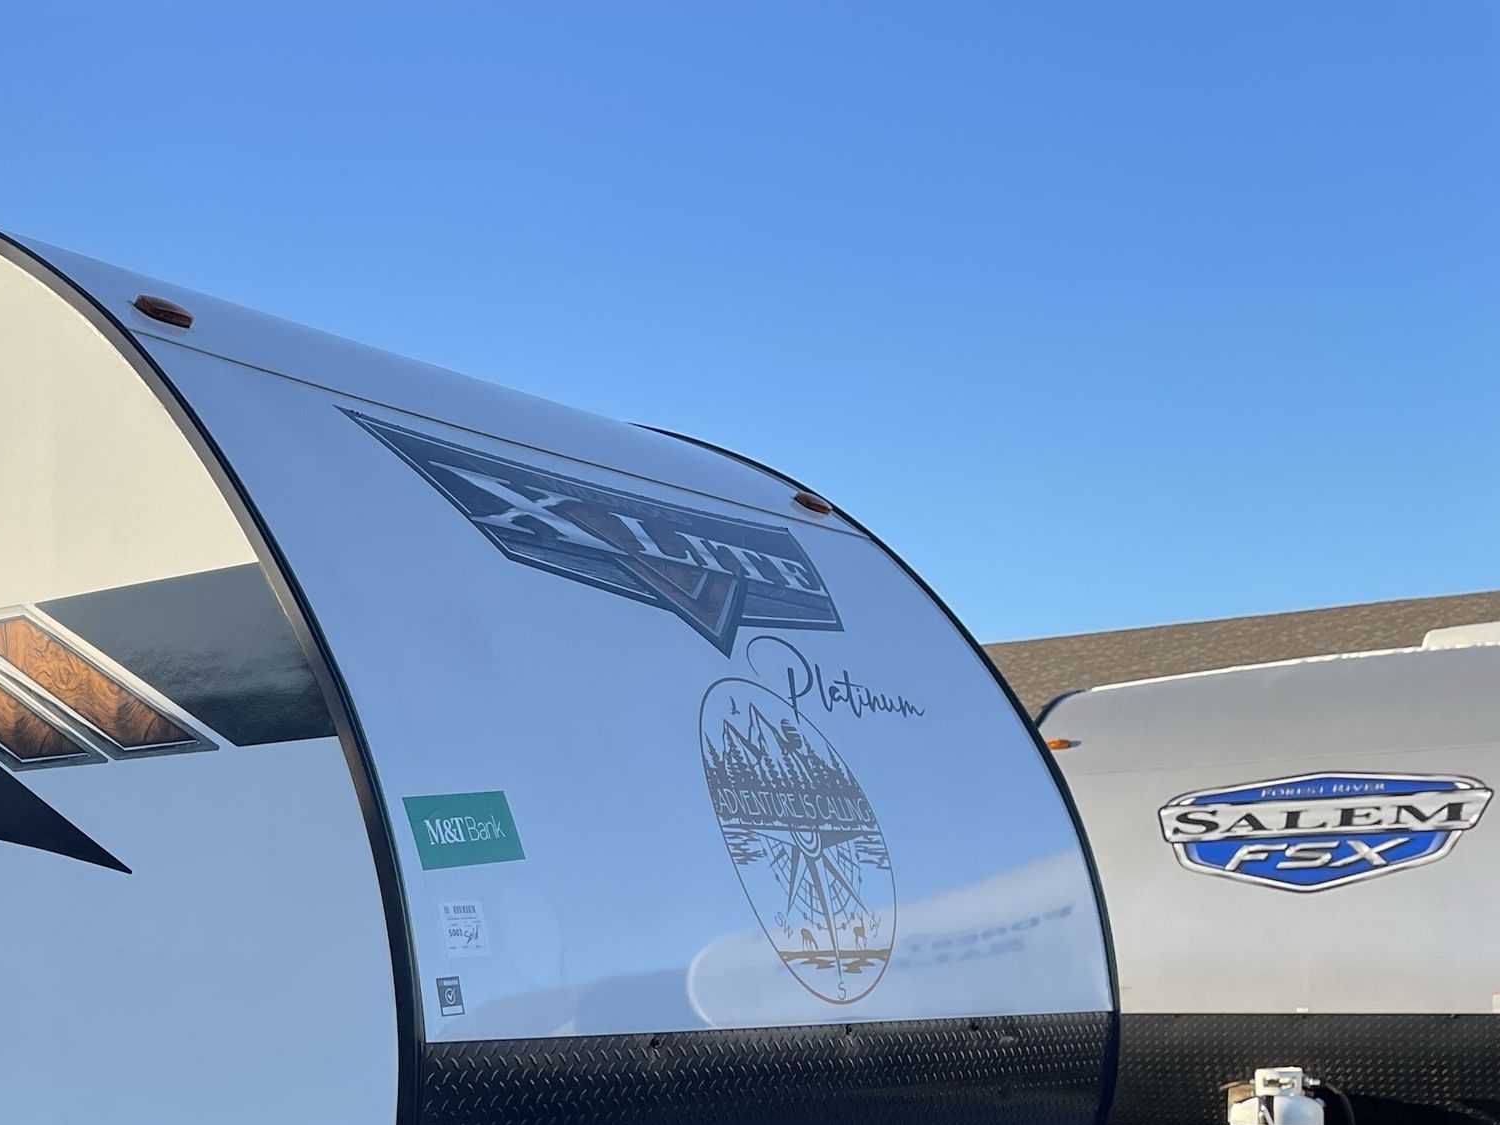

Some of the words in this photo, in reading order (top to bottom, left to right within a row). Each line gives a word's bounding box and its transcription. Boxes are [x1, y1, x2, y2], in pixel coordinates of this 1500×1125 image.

[428, 459, 632, 556] X
[608, 511, 831, 599] LITE
[746, 635, 926, 725] Platinum
[717, 787, 803, 819] ADVENTURE
[799, 792, 817, 820] IS
[815, 794, 871, 822] CALLING
[1332, 782, 1385, 793] RIVER
[1171, 802, 1470, 835] SALEM
[1224, 837, 1410, 872] FSX
[837, 981, 847, 1000] S
